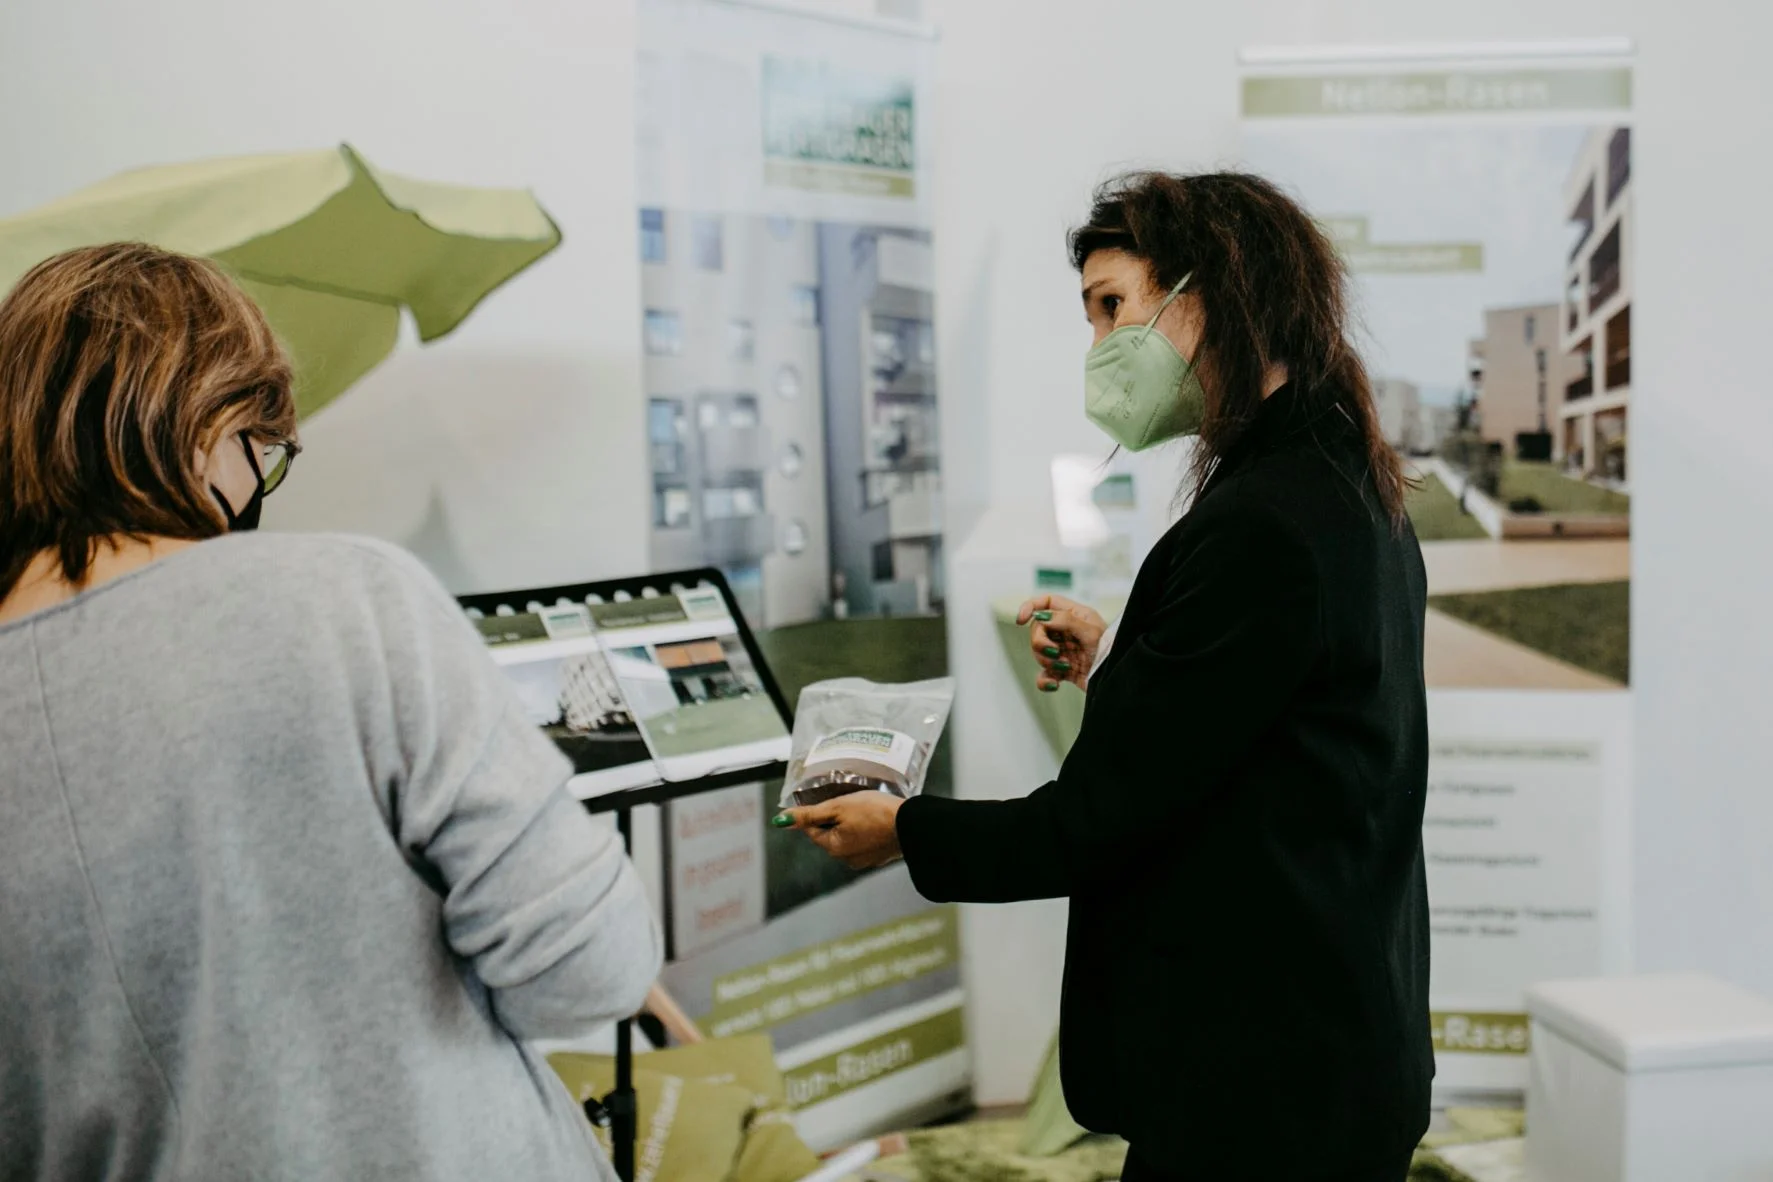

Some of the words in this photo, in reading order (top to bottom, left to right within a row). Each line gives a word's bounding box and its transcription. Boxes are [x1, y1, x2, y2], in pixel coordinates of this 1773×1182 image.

[1321, 76, 1549, 110] Netlon-Rasen
[1431, 1015, 1525, 1049] -Rase
[786, 1039, 914, 1107] lon-Rasen
